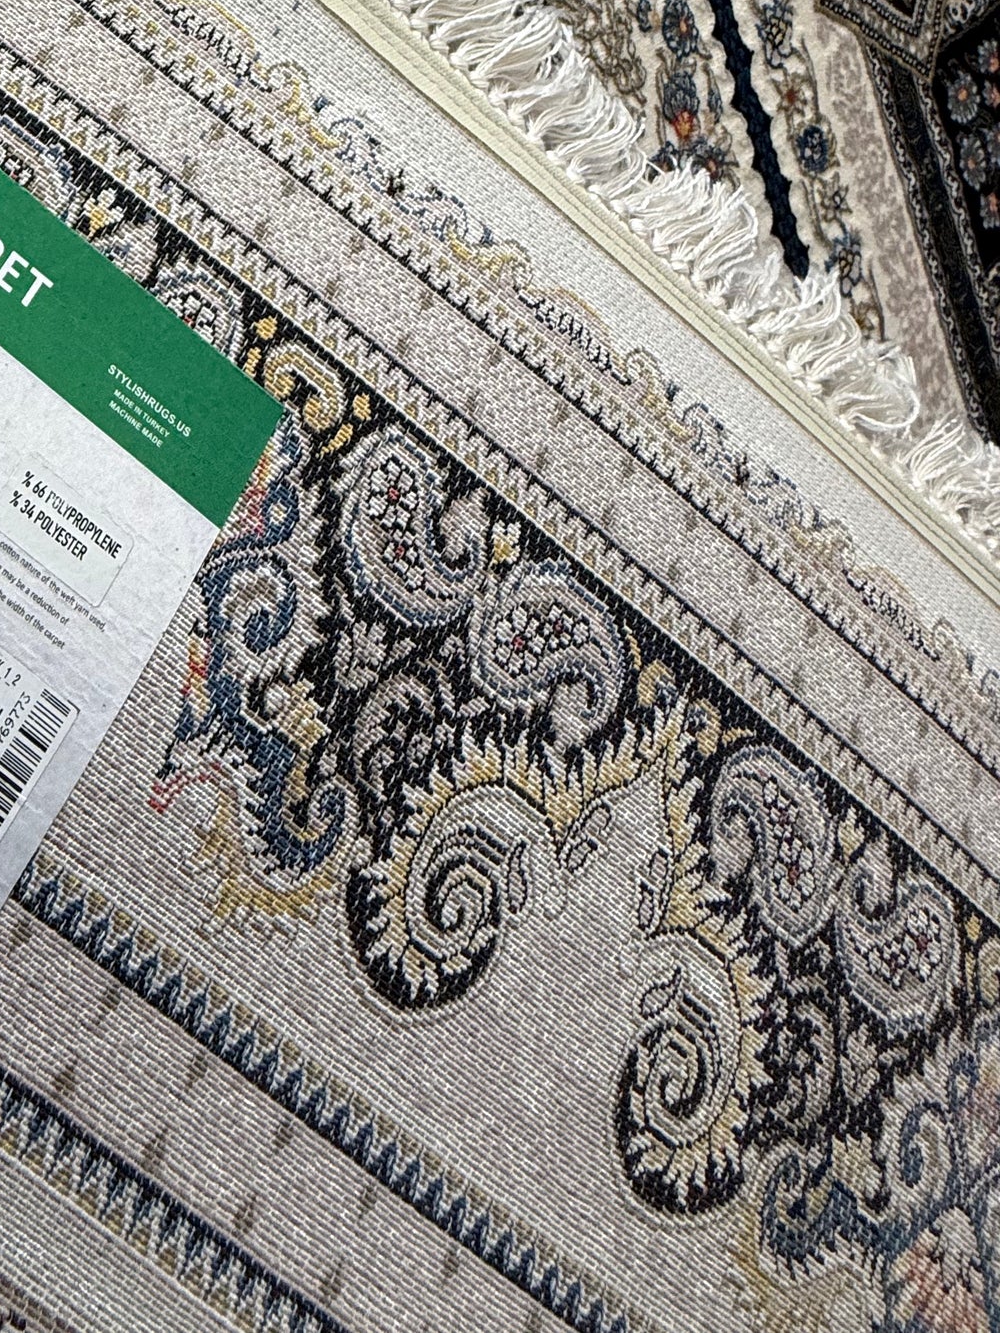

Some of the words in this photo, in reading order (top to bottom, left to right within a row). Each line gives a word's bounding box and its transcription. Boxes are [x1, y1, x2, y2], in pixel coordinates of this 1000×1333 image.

[107, 363, 192, 438] STYLISHRUGS.US
[108, 399, 143, 431] MACHINE
[140, 426, 163, 448] MADE
[112, 388, 135, 409] MADE
[133, 405, 143, 416] IN
[141, 411, 171, 438] TURKEY
[8, 489, 23, 508] %
[19, 498, 36, 519] 34
[32, 509, 88, 561] POLYESTER
[21, 470, 35, 488] %
[31, 480, 48, 499] 66
[44, 490, 122, 559] POLYPROPYLENE
[0, 567, 18, 585] may
[14, 577, 26, 592] be
[23, 587, 31, 596] a
[29, 591, 61, 620] reduction
[59, 615, 70, 626] of
[5, 597, 26, 617] width
[23, 613, 35, 624] of
[31, 618, 45, 633] the
[42, 628, 66, 650] carpet
[18, 557, 42, 579] nature
[39, 574, 52, 585] of
[47, 579, 61, 595] the
[59, 589, 76, 607] weft
[72, 601, 90, 618] yarn
[88, 613, 107, 634] used,
